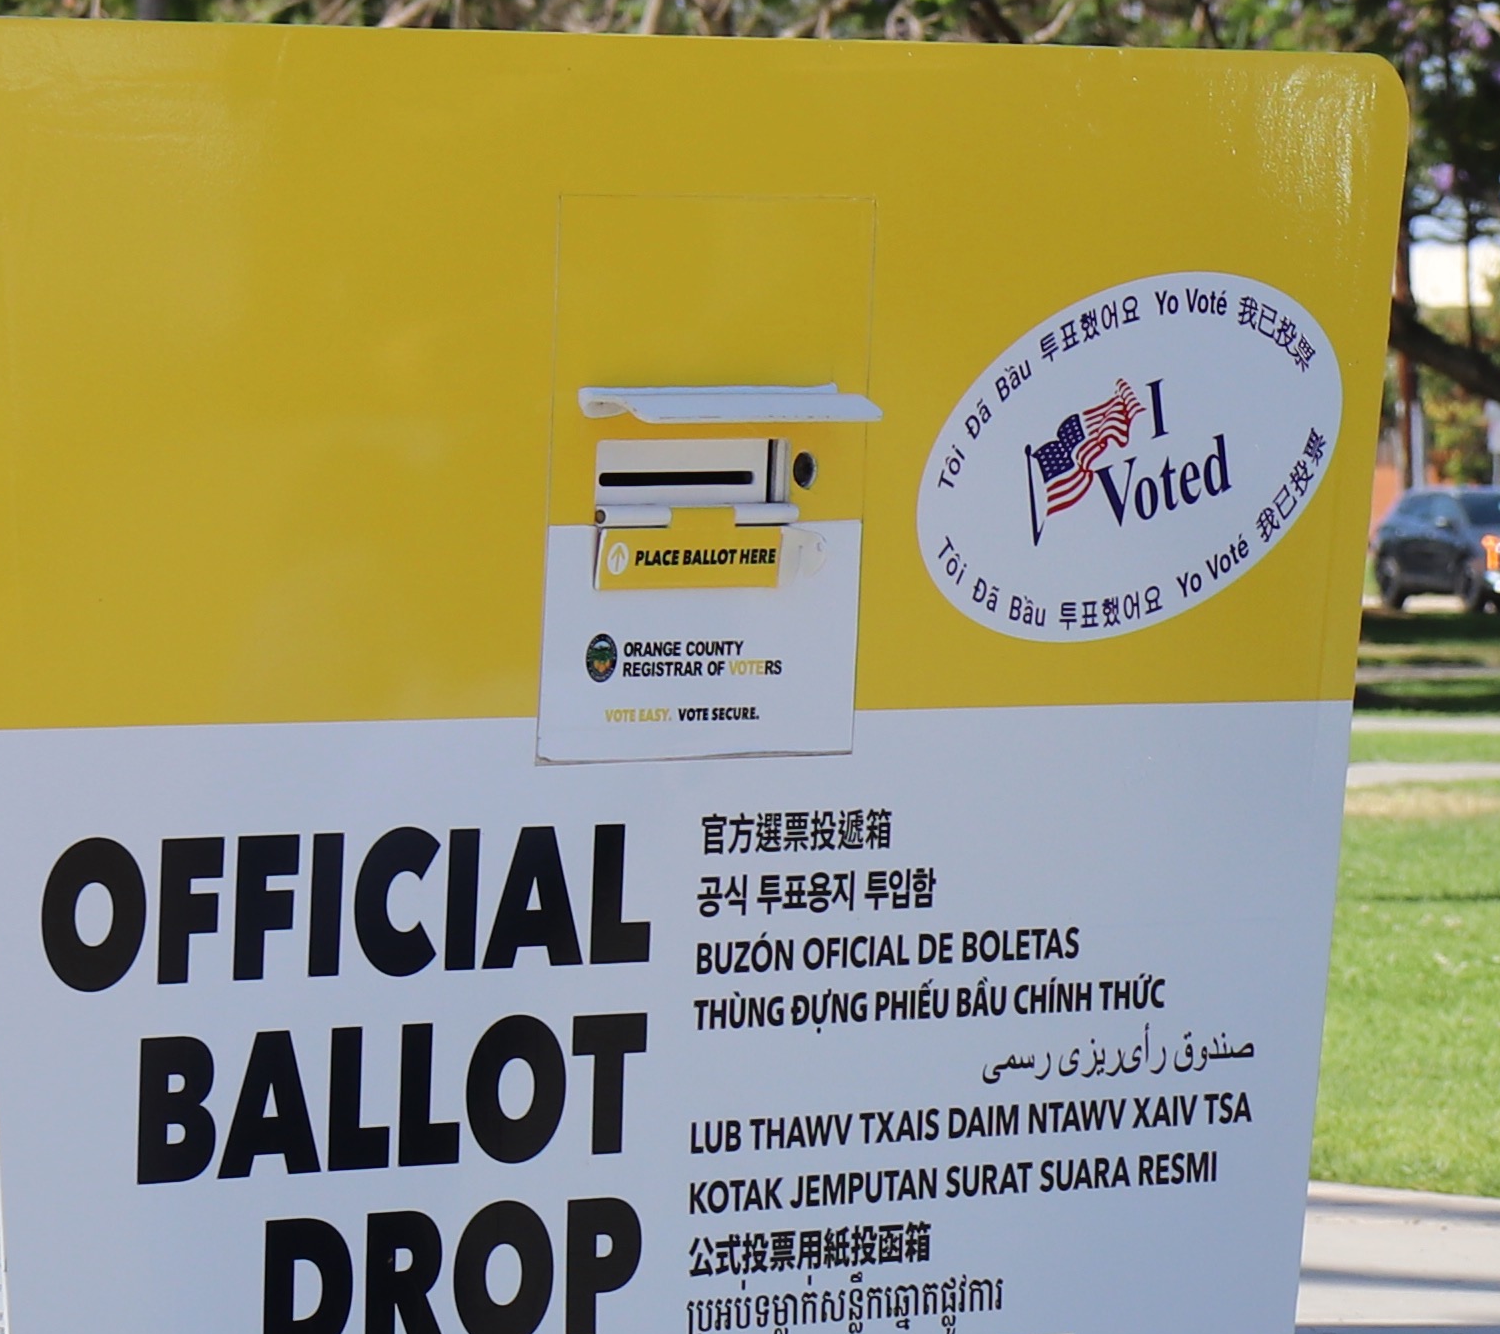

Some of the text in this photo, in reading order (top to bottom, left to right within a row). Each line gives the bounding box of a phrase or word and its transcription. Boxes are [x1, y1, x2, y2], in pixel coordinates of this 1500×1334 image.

[938, 289, 1315, 488] Tôi Đã Bầu 투표했어요 Yo Voté 我已投票
[1147, 379, 1168, 438] I
[1094, 434, 1232, 527] Voted
[938, 428, 1326, 630] Tôi Đã Bầu 투표했어요 Yo Voté 我已投票
[635, 548, 776, 566] PLACE BALLOT HERE
[622, 659, 782, 678] REGISTRAR OF VOTERS
[623, 640, 744, 657] ORANGE COUNTY
[605, 707, 760, 722] VOTE EASY. VOTE SECURE.
[702, 809, 892, 855] 官方選票投遞箱
[42, 824, 650, 992] OFFICIAL
[697, 868, 936, 917] 공식 투표용지 투입함
[697, 927, 1079, 974] BUZÓN OFICIAL DE BOLETAS
[694, 973, 1165, 1033] THÙNG ĐỰNG PHIẾU BẦU CHÍNH THỨC
[982, 1045, 1052, 1085] رسمی
[1174, 1030, 1255, 1075] صندوق
[137, 1013, 647, 1185] BALLOT
[691, 1092, 1251, 1154] LUB THAWV TXAIS DAIM NTAWV XAIV TSA
[690, 1151, 1216, 1214] KOTAK JEMPUTAN SURAT SUARA RESMI
[689, 1221, 931, 1276] 公式投票用紙投函箱
